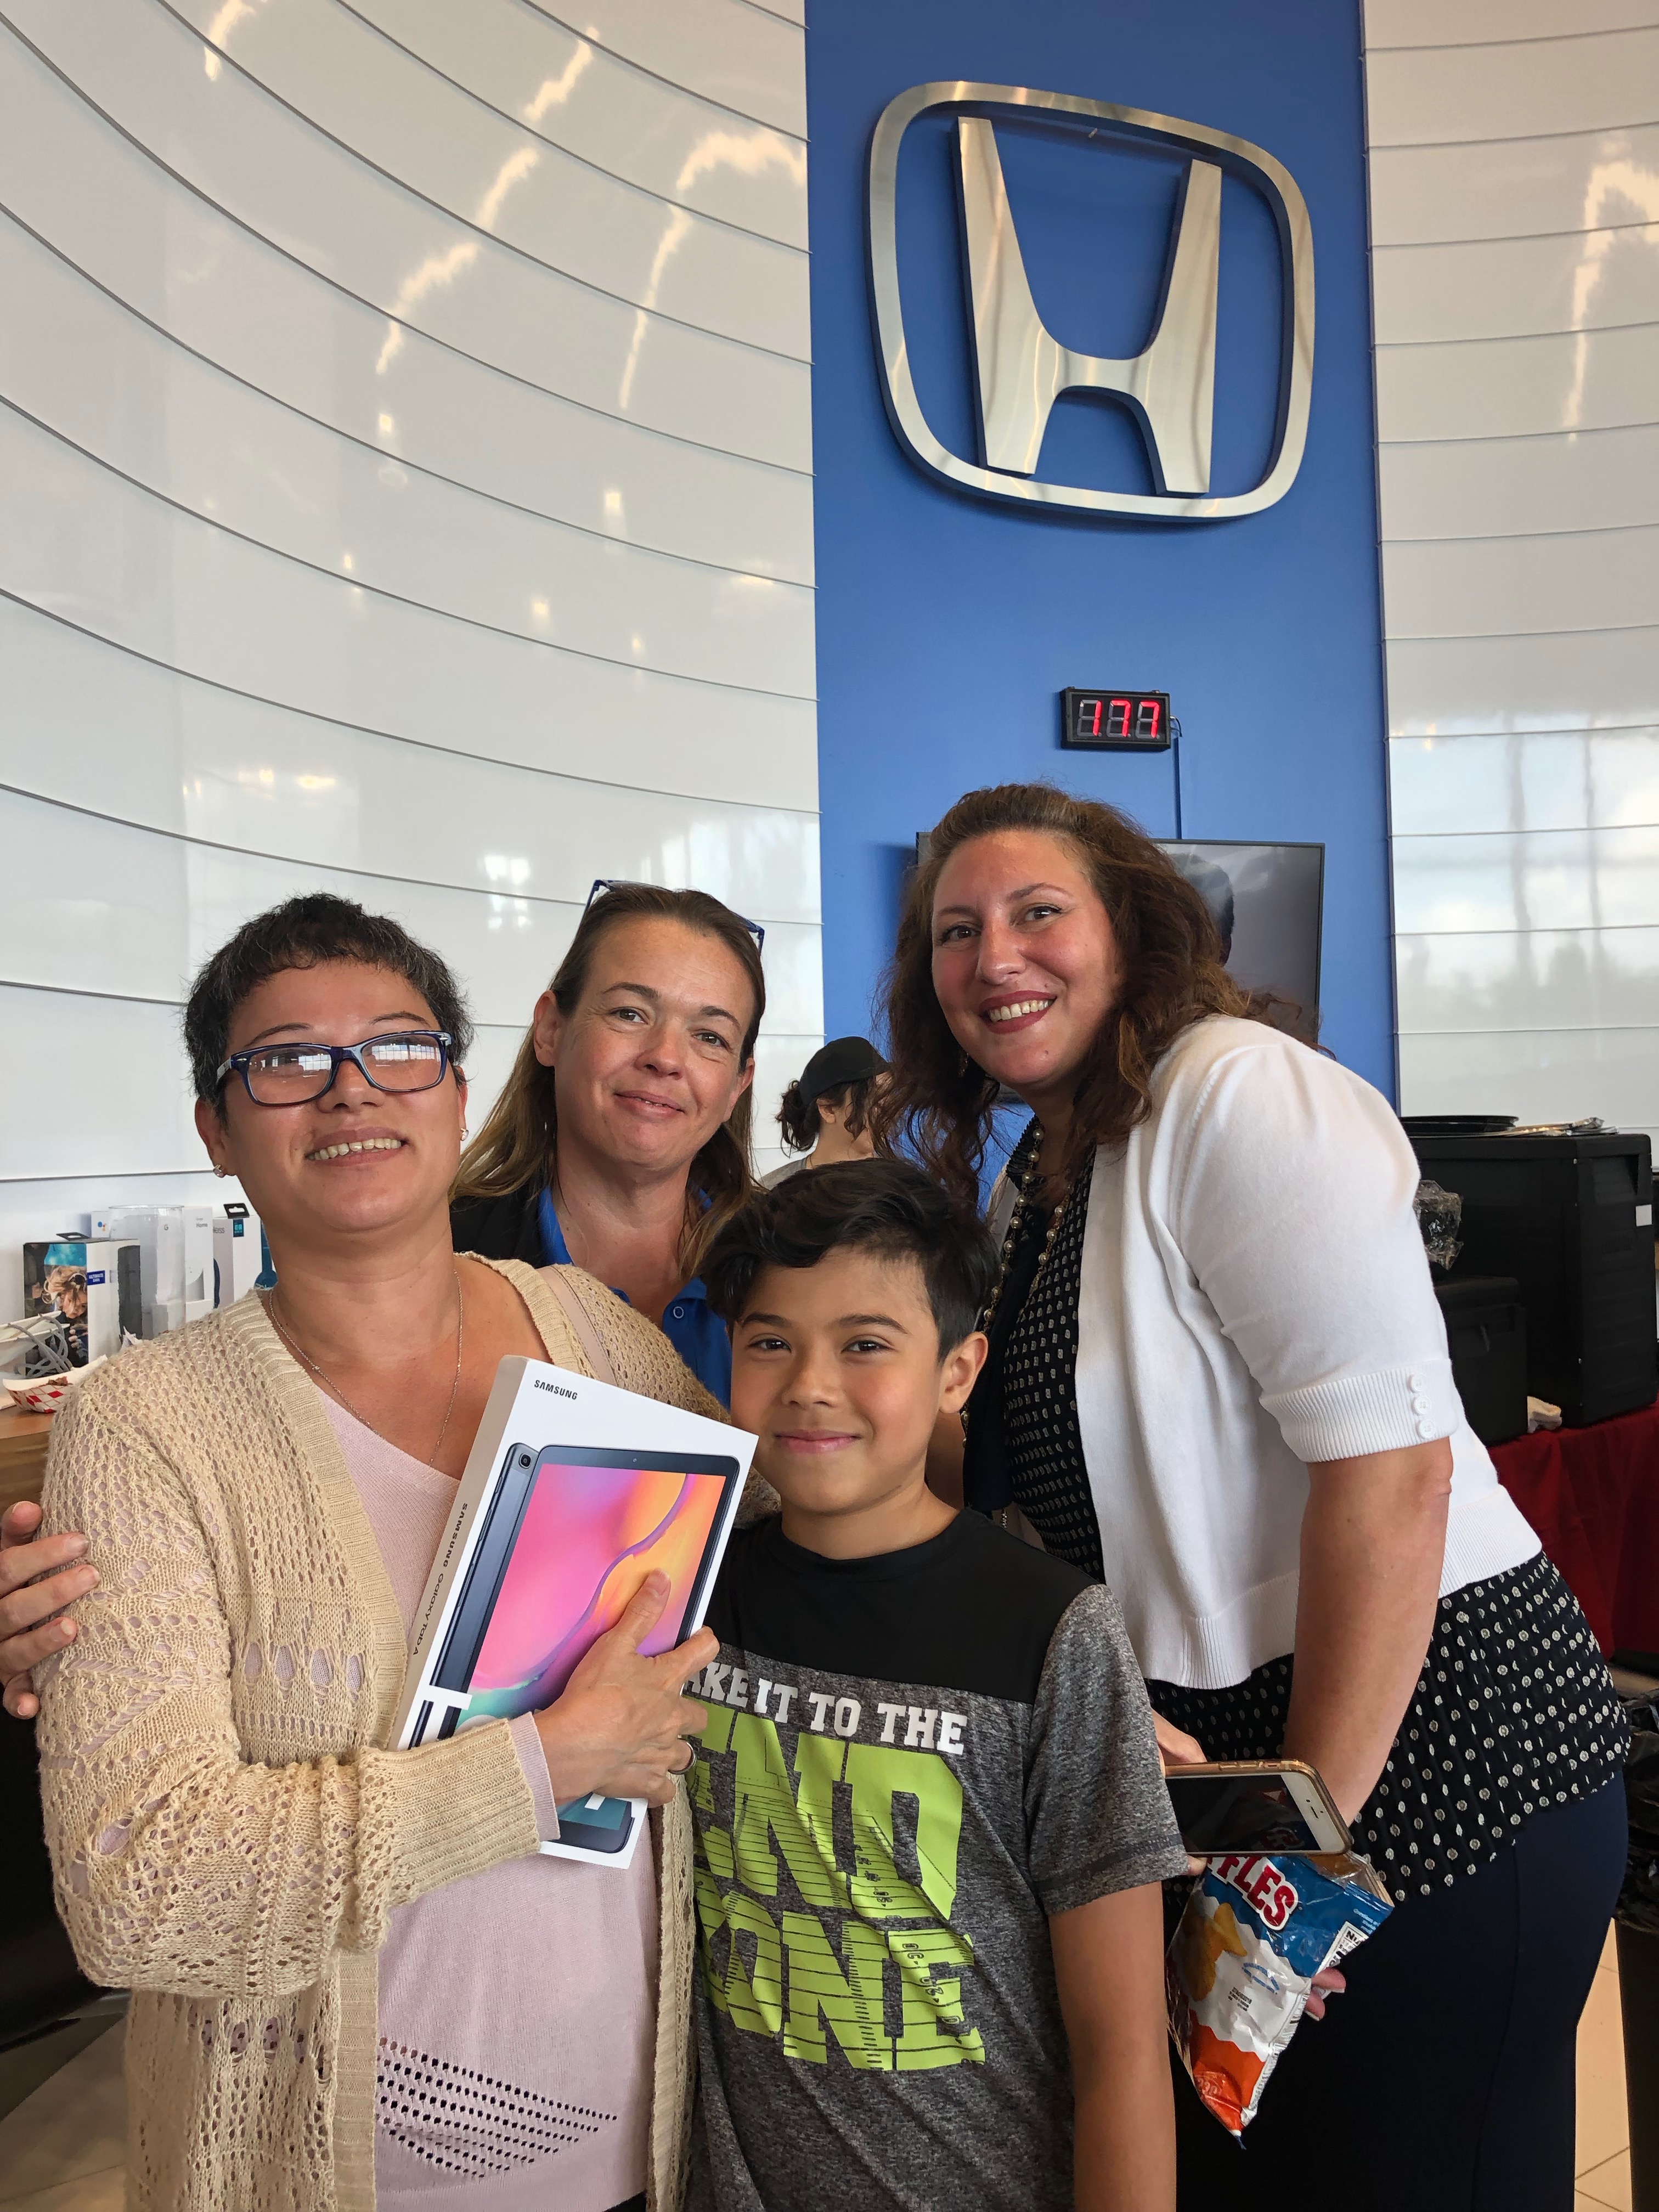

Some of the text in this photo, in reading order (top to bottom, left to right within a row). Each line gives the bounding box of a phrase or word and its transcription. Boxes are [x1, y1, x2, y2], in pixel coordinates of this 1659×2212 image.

[1092, 699, 1160, 738] 177
[534, 1379, 578, 1400] SAMSUNG
[443, 1503, 468, 1568] SAMSUNG
[425, 1573, 444, 1621] Galaxy
[754, 1678, 798, 1724] IT
[808, 1692, 861, 1737] TO
[878, 1702, 968, 1755] THE
